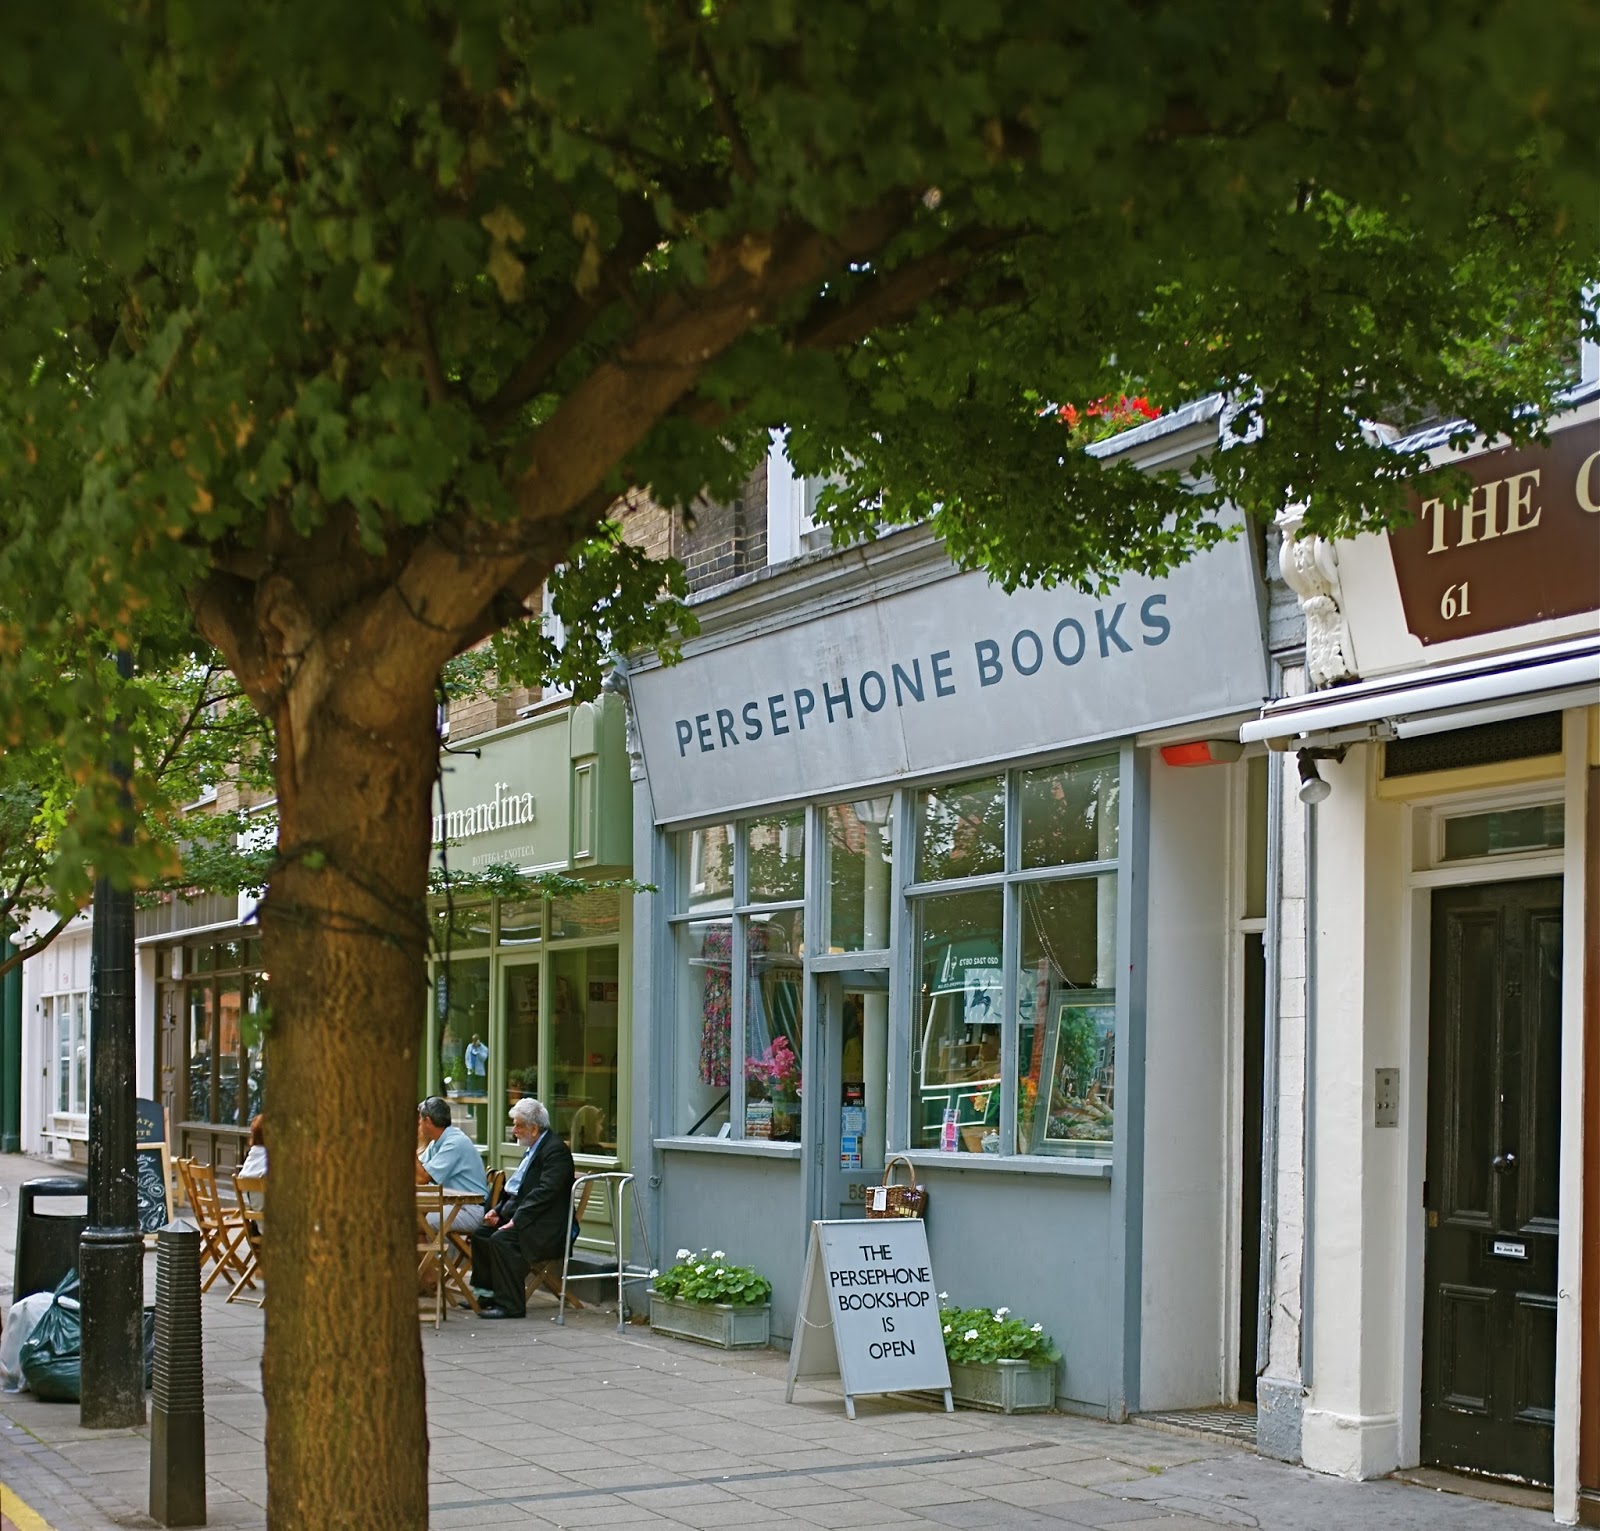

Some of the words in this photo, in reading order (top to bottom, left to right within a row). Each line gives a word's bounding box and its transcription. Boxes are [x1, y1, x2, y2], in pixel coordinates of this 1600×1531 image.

[1421, 469, 1542, 555] THE
[1440, 581, 1471, 620] 61
[675, 650, 956, 758] PERSEPHONE
[974, 594, 1172, 687] BOOKS
[859, 1244, 893, 1262] THE
[830, 1266, 931, 1288] PERSEPHONE
[838, 1291, 930, 1311] BOOKSHOP
[881, 1317, 895, 1333] IS
[868, 1340, 916, 1360] OPEN
